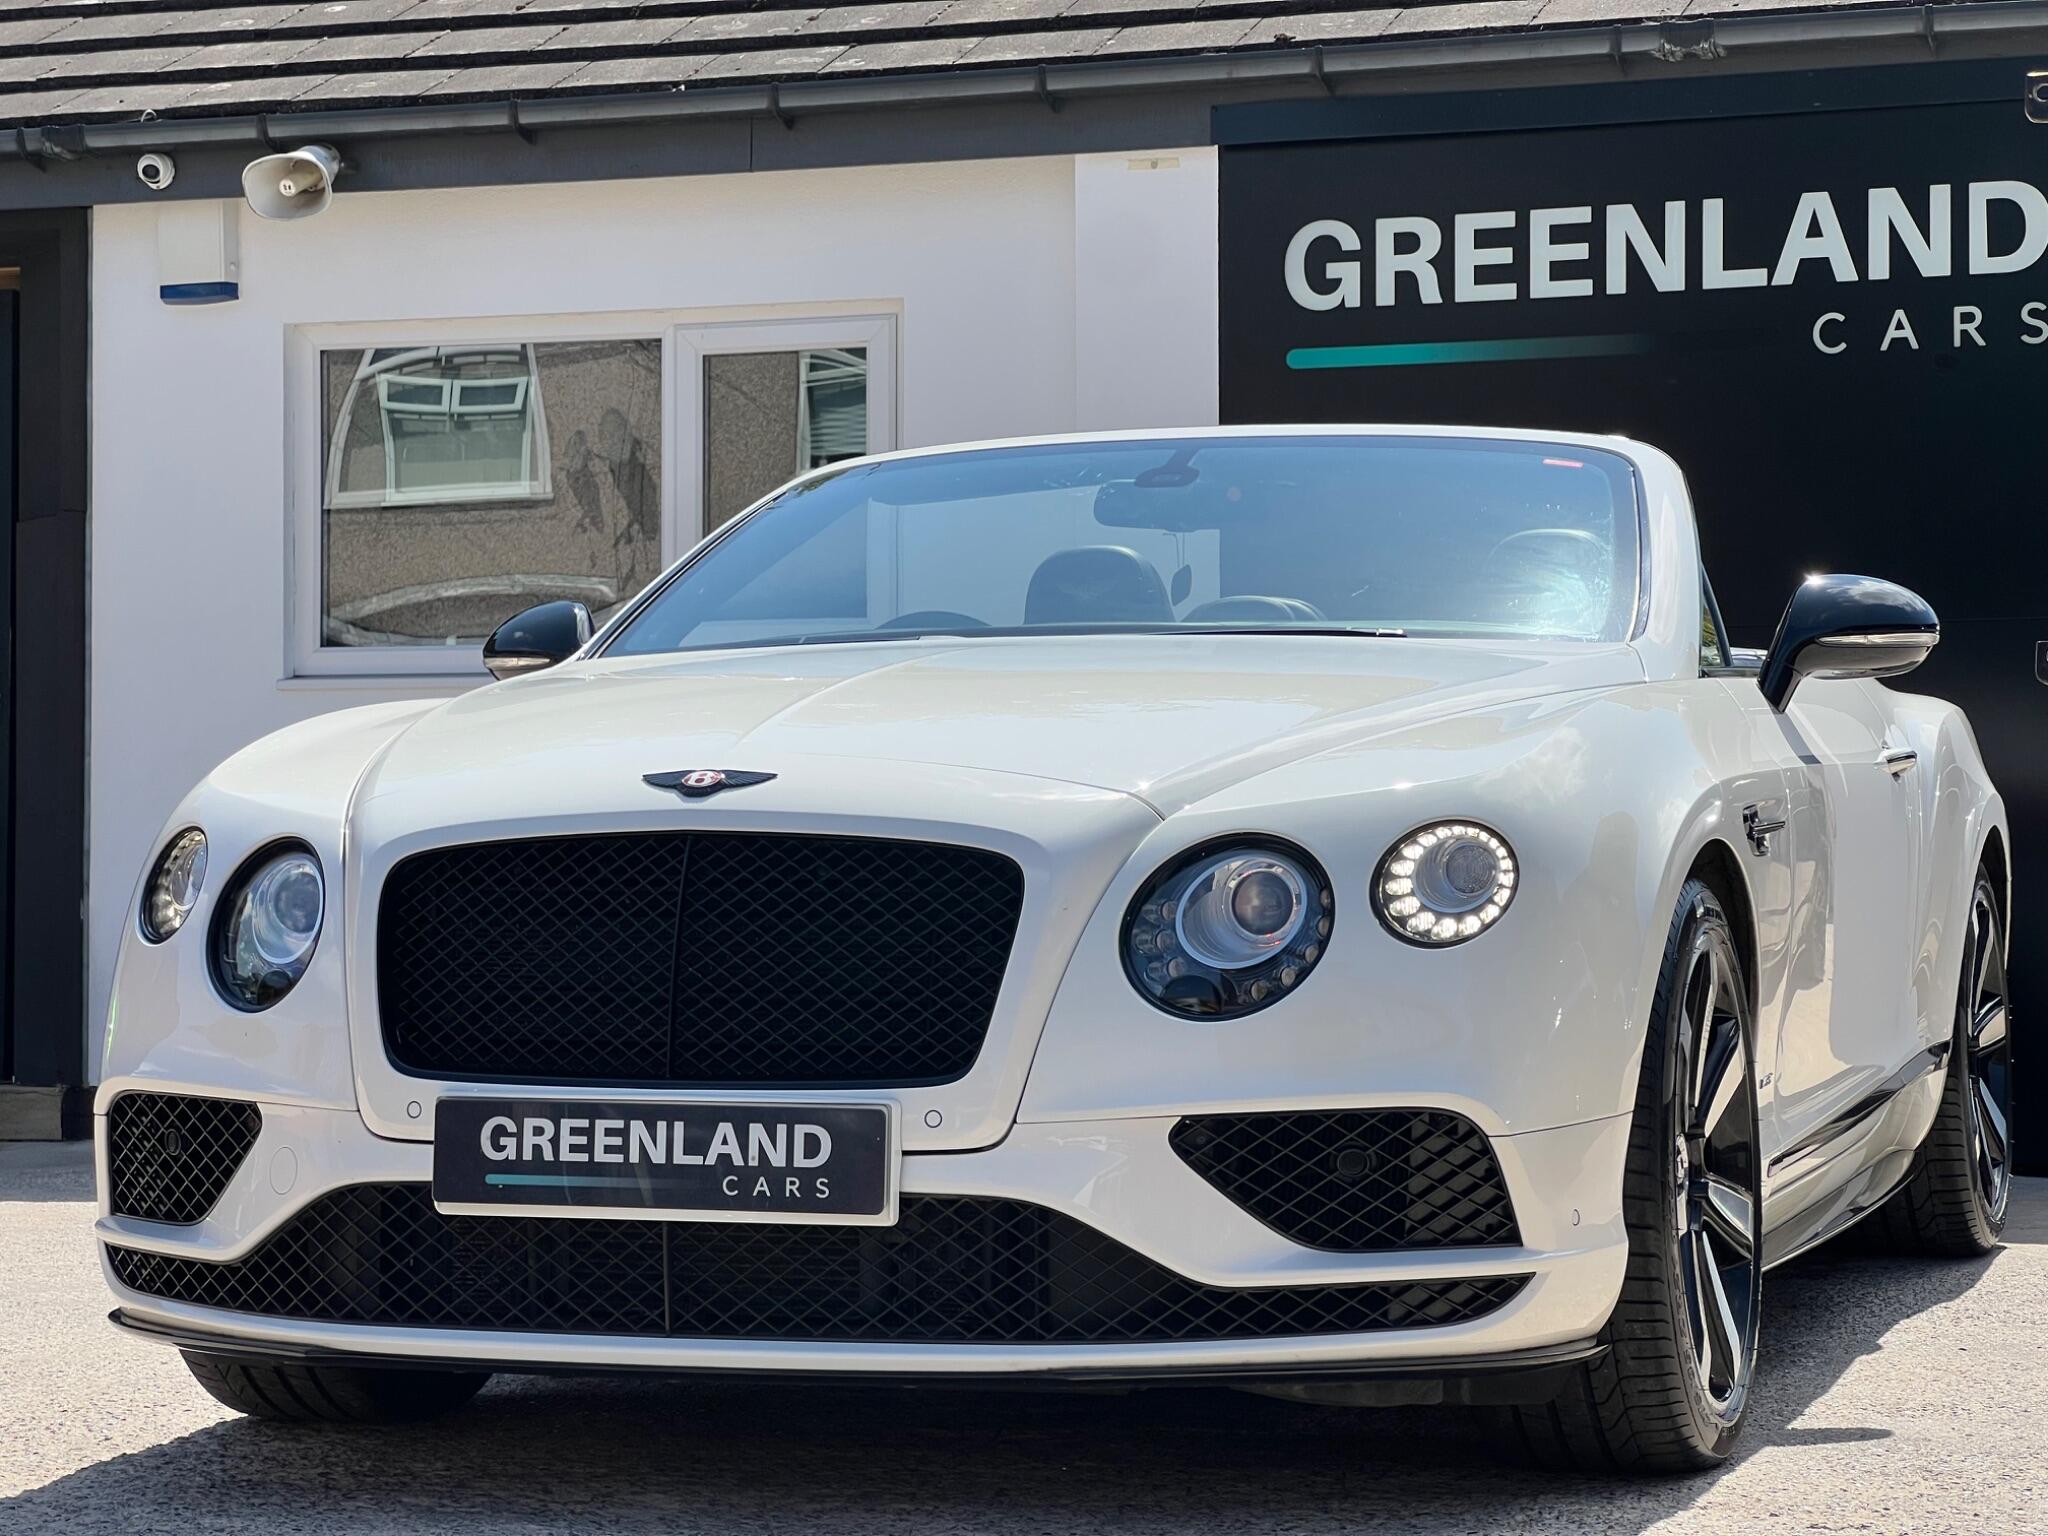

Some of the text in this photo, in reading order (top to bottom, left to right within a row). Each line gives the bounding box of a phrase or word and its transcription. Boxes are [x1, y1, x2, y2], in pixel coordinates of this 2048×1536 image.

[1285, 180, 2048, 311] GREENLAND
[1812, 302, 2048, 355] CARS
[480, 1116, 832, 1168] GREENLAND
[722, 1175, 830, 1199] CARS
